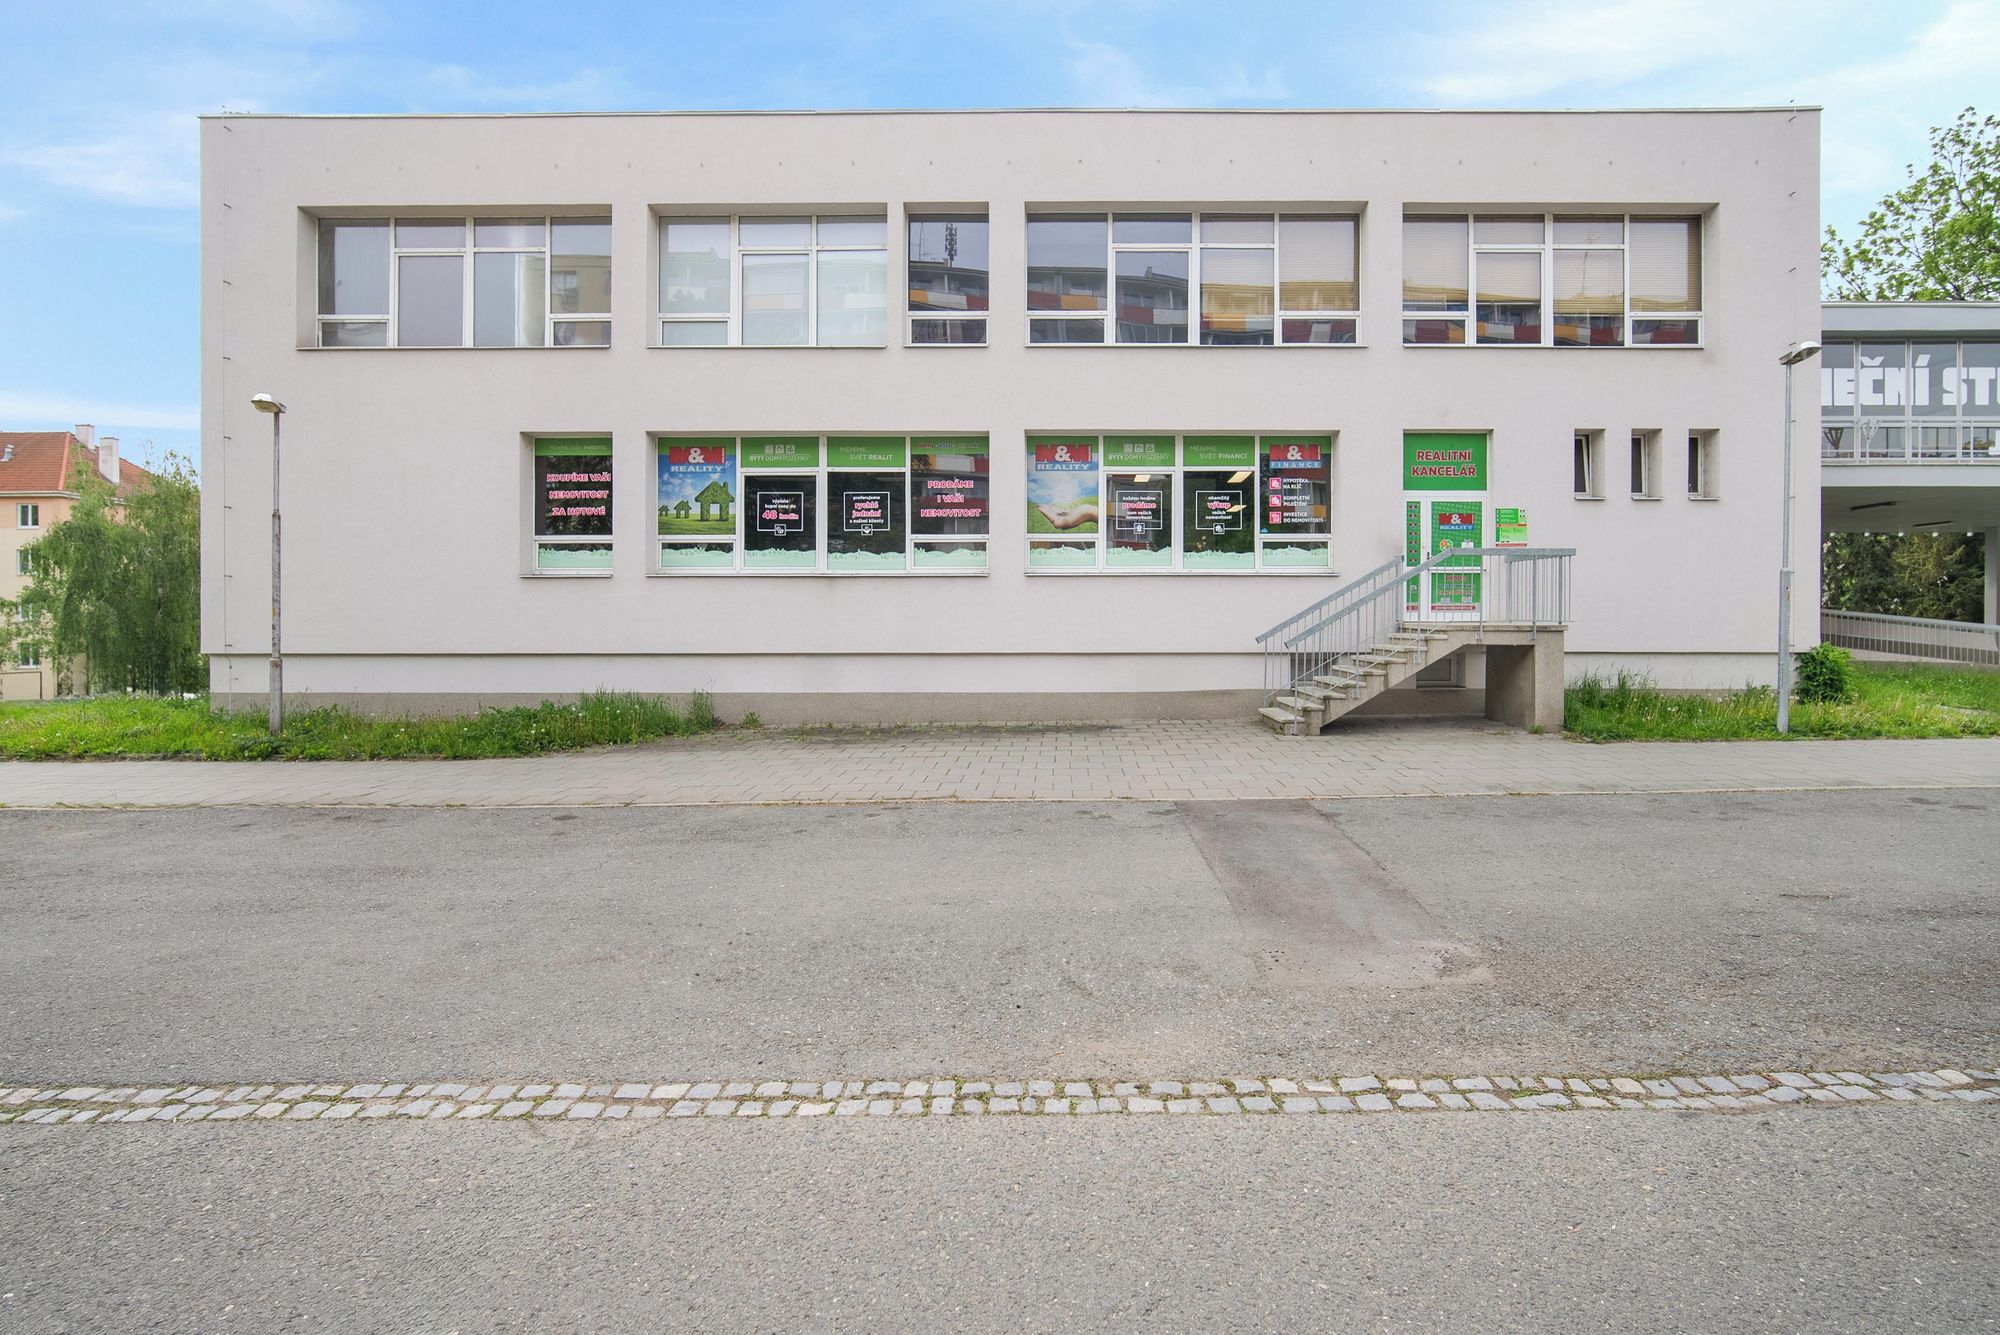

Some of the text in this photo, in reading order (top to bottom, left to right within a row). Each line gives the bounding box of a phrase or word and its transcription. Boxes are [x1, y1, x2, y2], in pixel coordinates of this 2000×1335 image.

[1942, 367, 2000, 406] ST
[669, 447, 723, 464] M&M
[1036, 445, 1089, 462] M&M
[1218, 452, 1247, 460] FINANCÍ
[1270, 446, 1318, 461] M&M
[1416, 449, 1473, 462] REALITNÍ
[1411, 463, 1477, 477] KANCELÁŘ
[546, 471, 611, 482] KOUPÍME VAŠI
[927, 479, 974, 489] PRODÁME
[549, 490, 609, 499] NEMOVITOST
[937, 492, 965, 503] I VAŠI
[552, 505, 606, 516] ZA HOTOVÉ
[1121, 501, 1157, 510] prodáme
[1206, 501, 1231, 510] výkup
[761, 510, 778, 520] 48
[920, 508, 981, 517] NEMOVITOST
[1439, 514, 1473, 525] M&M
